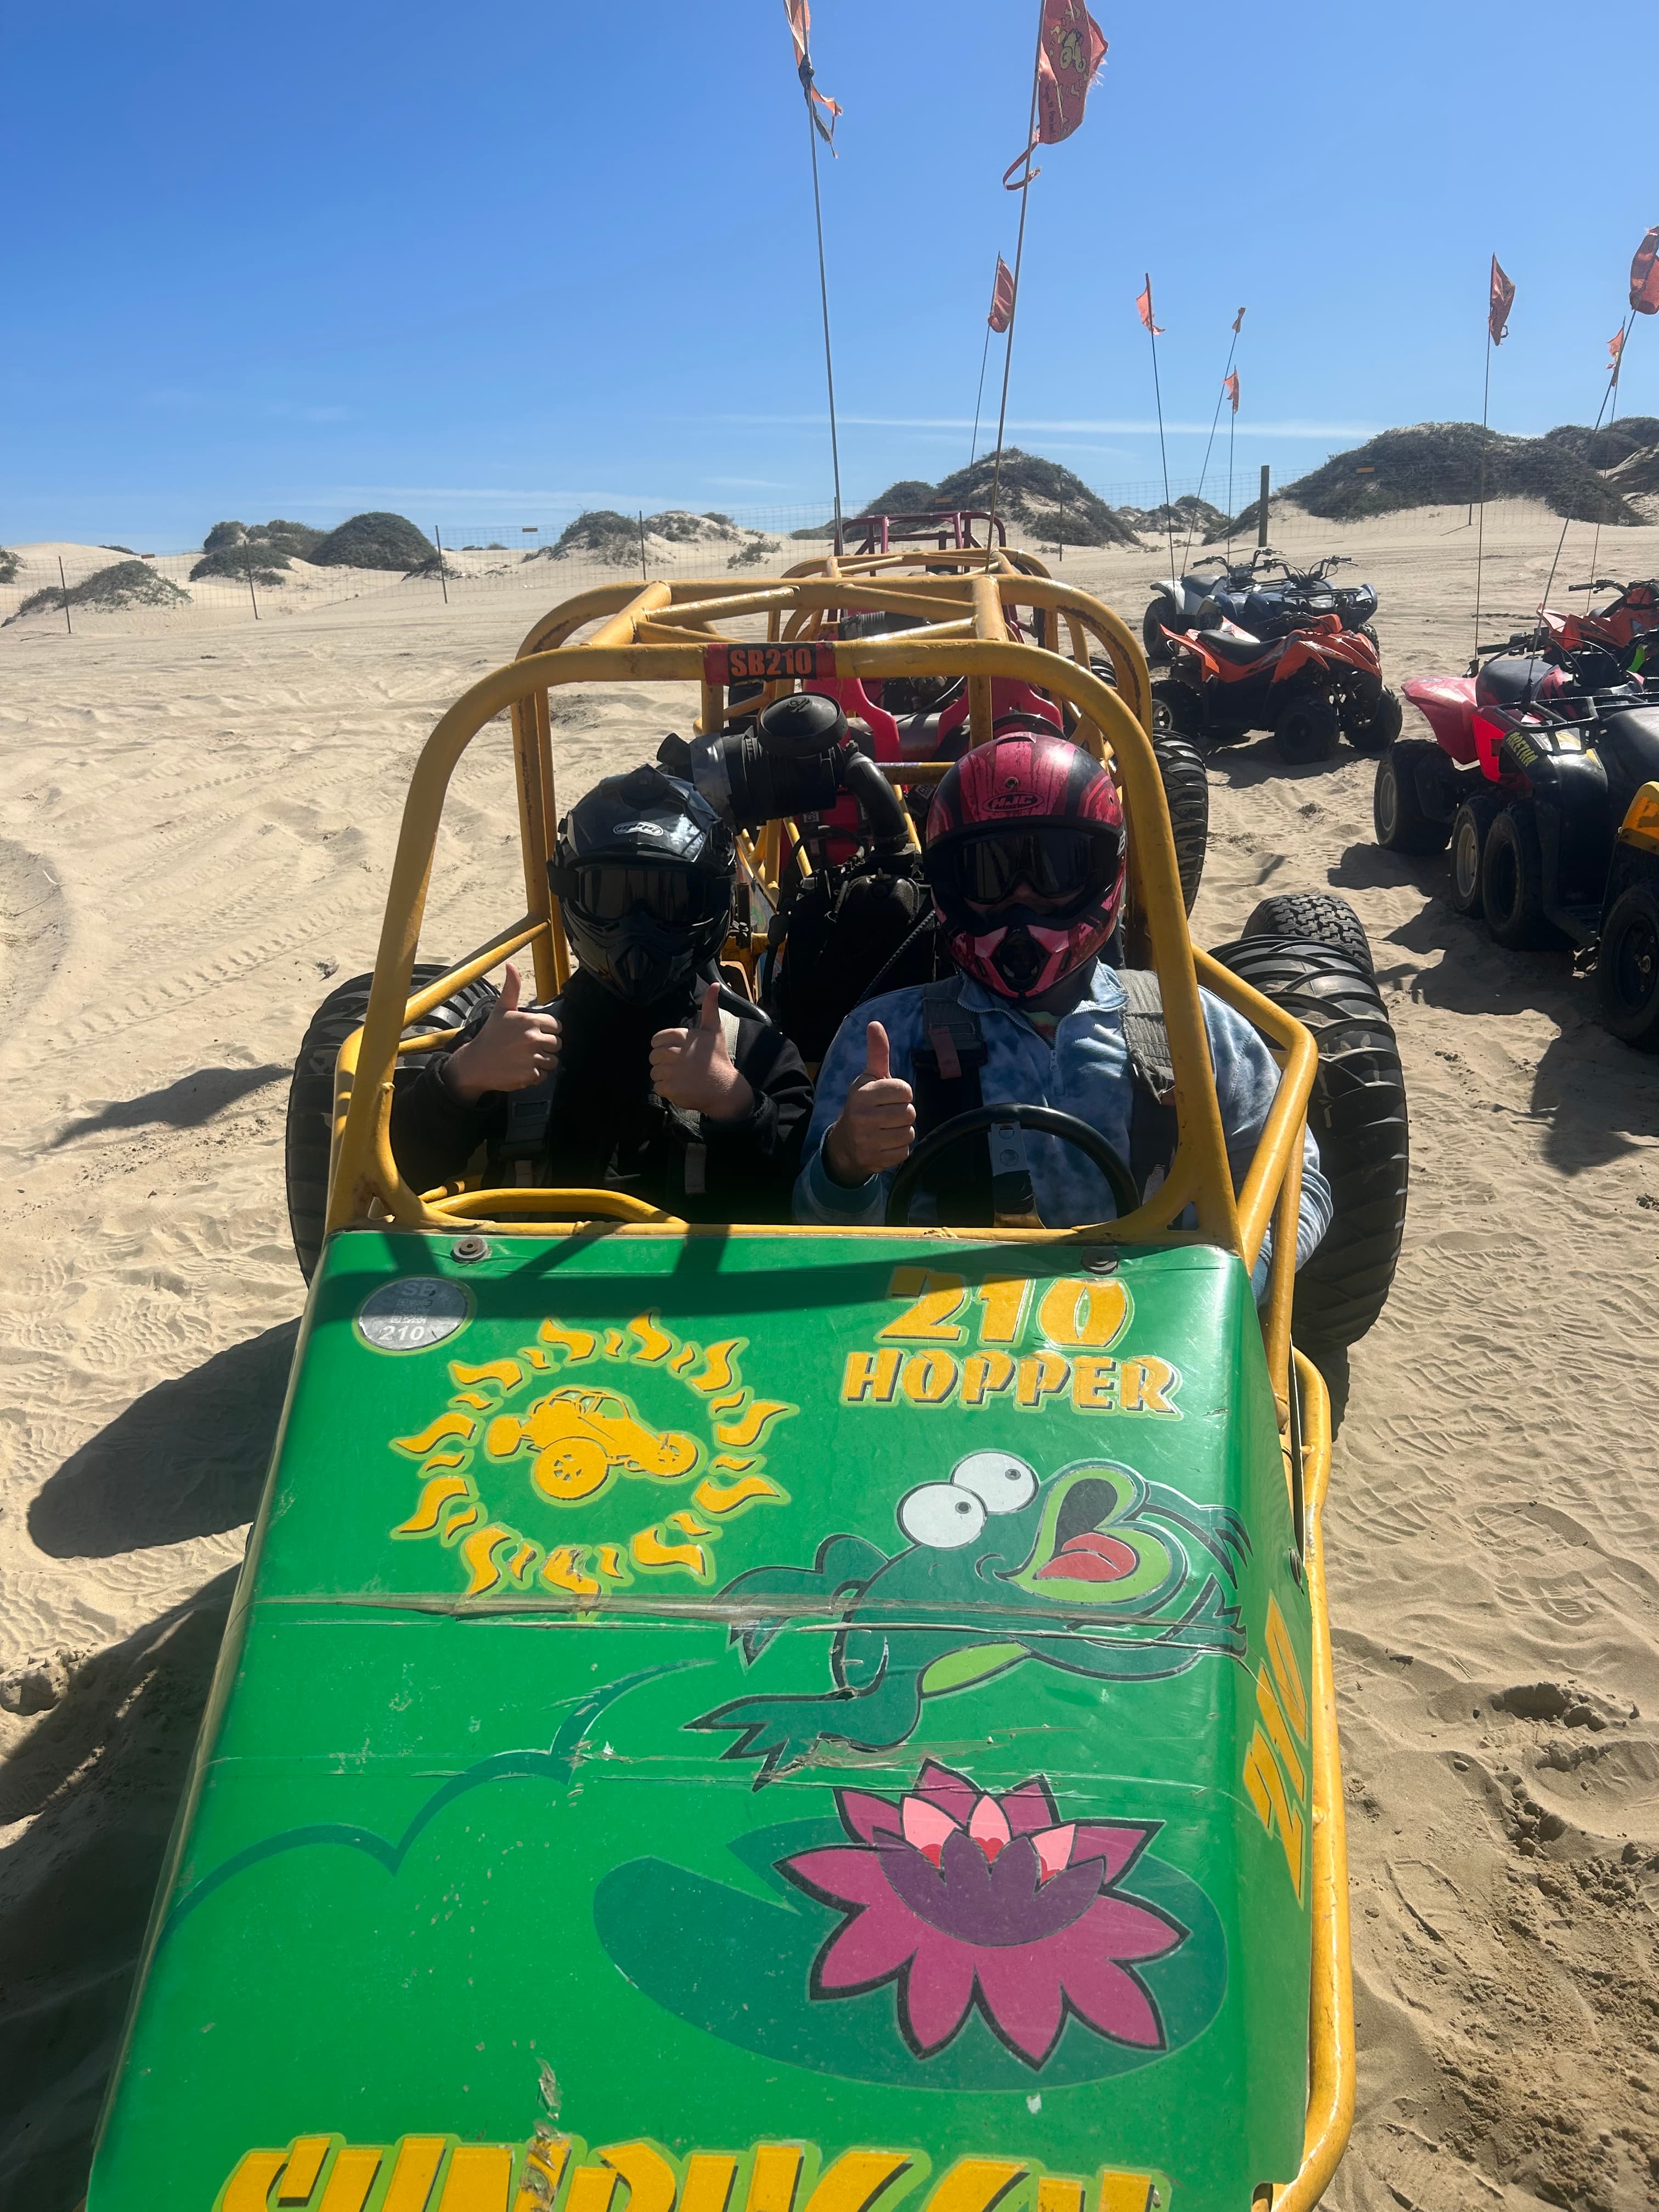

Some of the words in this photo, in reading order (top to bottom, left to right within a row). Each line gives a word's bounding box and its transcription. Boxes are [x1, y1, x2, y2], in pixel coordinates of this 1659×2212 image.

[730, 648, 812, 676] SB210
[1506, 732, 1538, 767] ARETHA
[991, 795, 1034, 809] HJC
[878, 1266, 1131, 1348] 210
[379, 1325, 425, 1341] 210
[842, 1348, 1181, 1418] HOPPER
